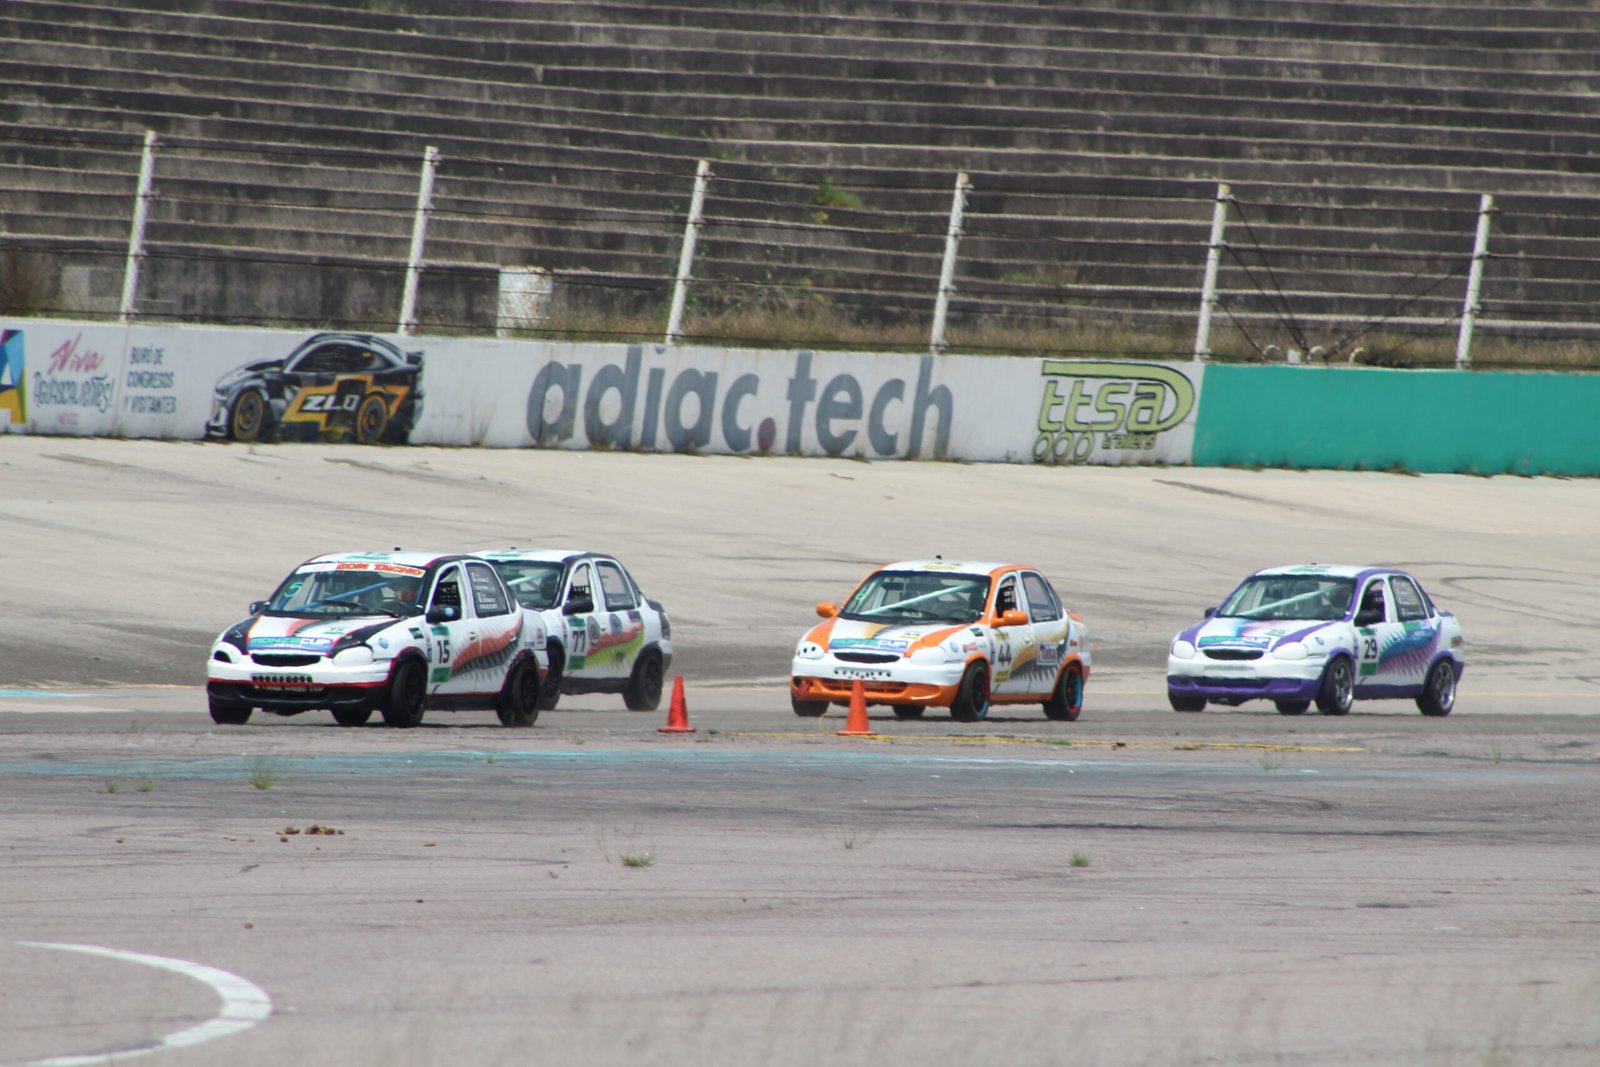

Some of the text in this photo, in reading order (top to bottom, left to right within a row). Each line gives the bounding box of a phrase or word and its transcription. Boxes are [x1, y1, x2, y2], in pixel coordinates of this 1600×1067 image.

[526, 344, 954, 460] adiac.tech
[437, 640, 450, 664] 15
[572, 630, 586, 652] 77
[1364, 639, 1378, 660] 29
[998, 643, 1012, 666] 44
